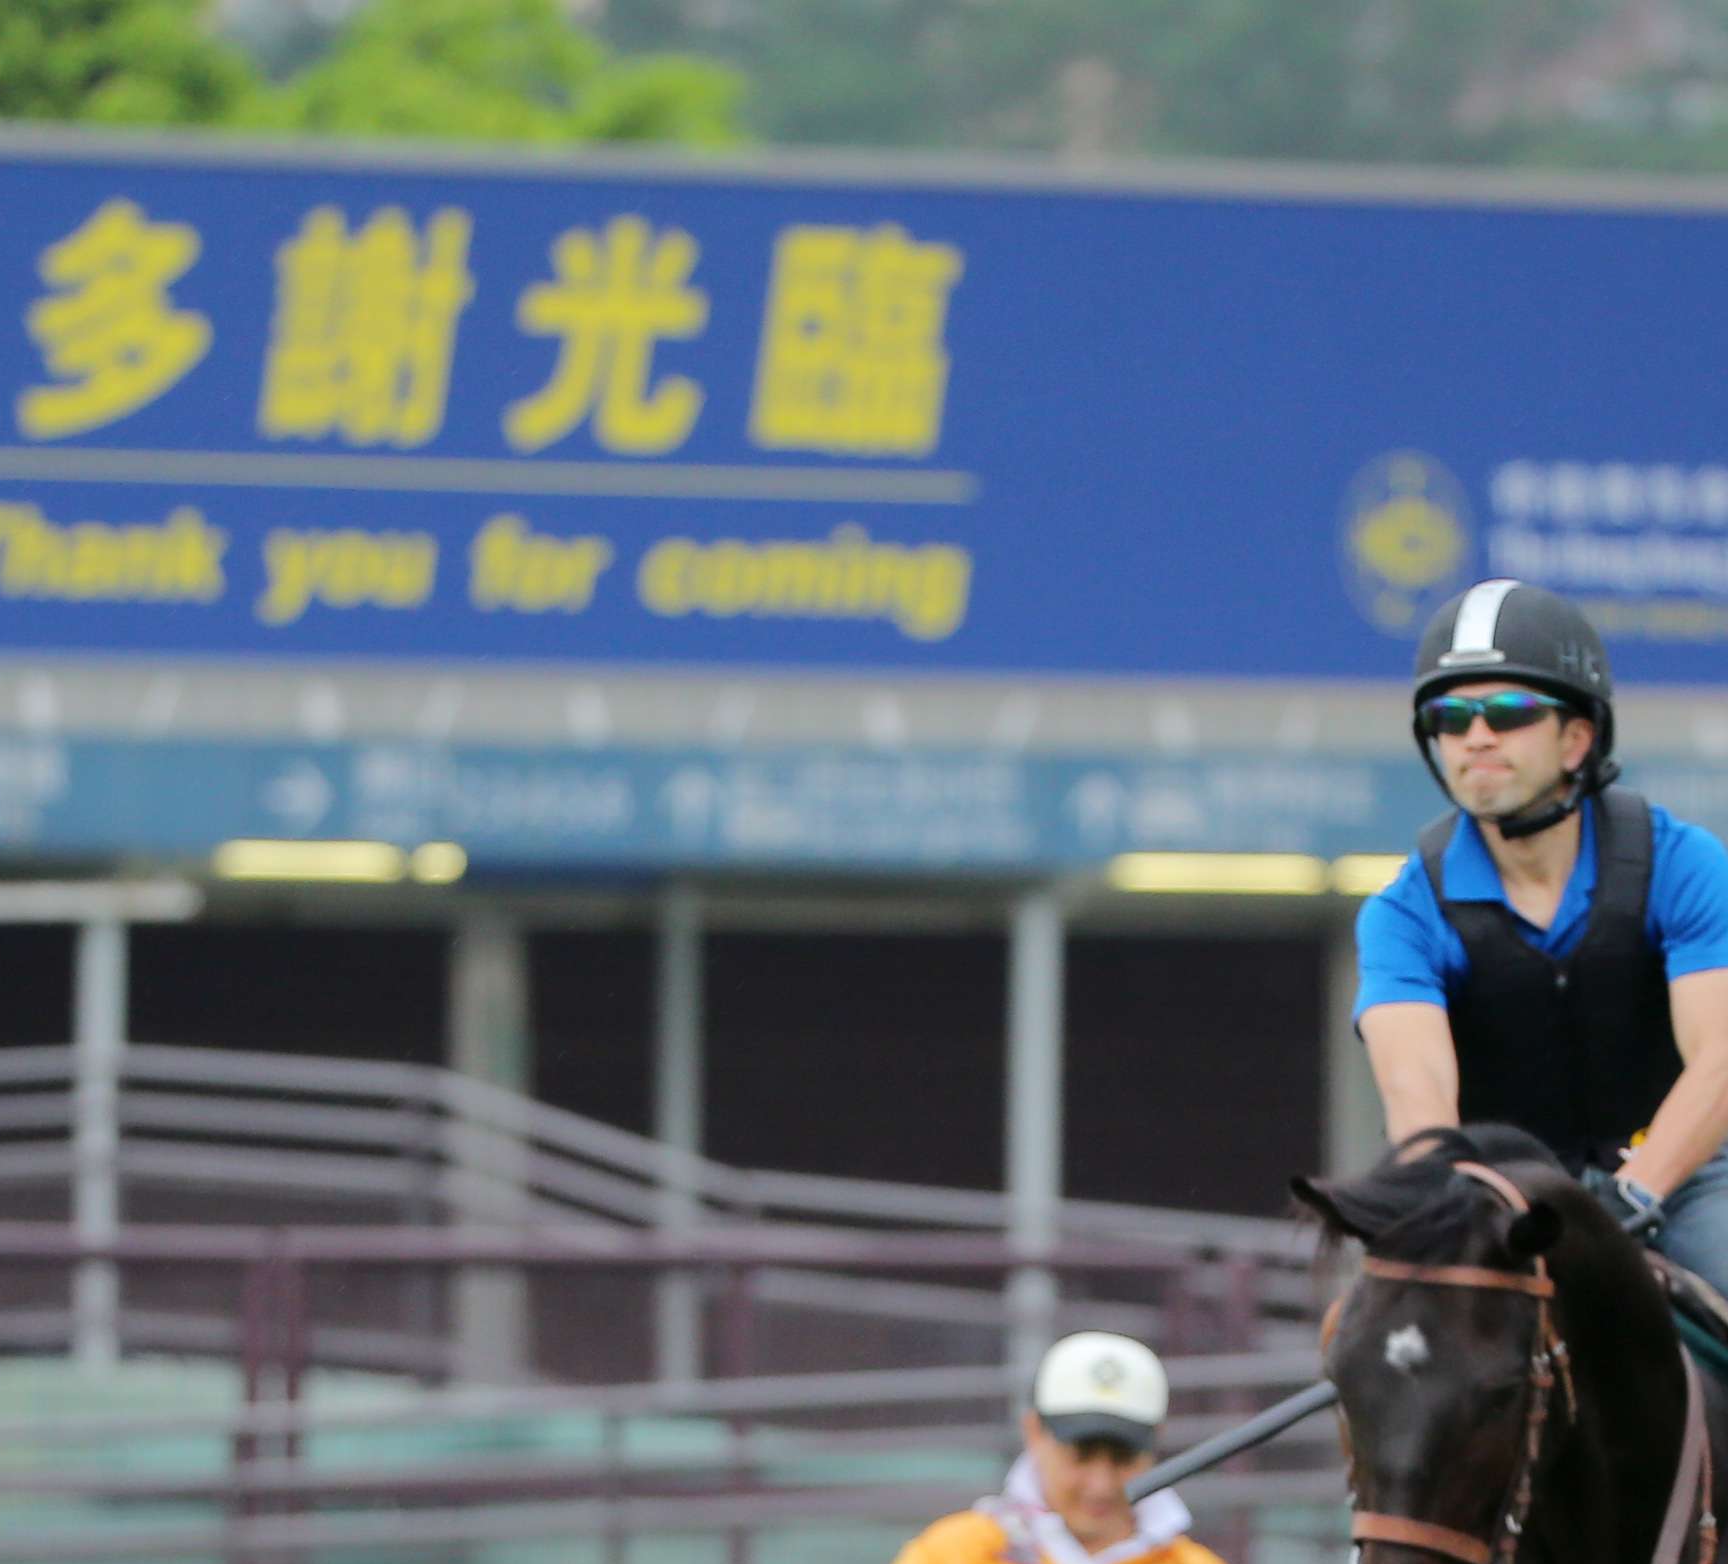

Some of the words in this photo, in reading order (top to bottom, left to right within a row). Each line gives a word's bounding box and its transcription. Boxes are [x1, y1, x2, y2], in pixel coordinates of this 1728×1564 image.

[16, 197, 964, 457] 多謝光臨
[257, 530, 437, 627] you
[470, 514, 610, 613] for
[638, 524, 969, 639] coming
